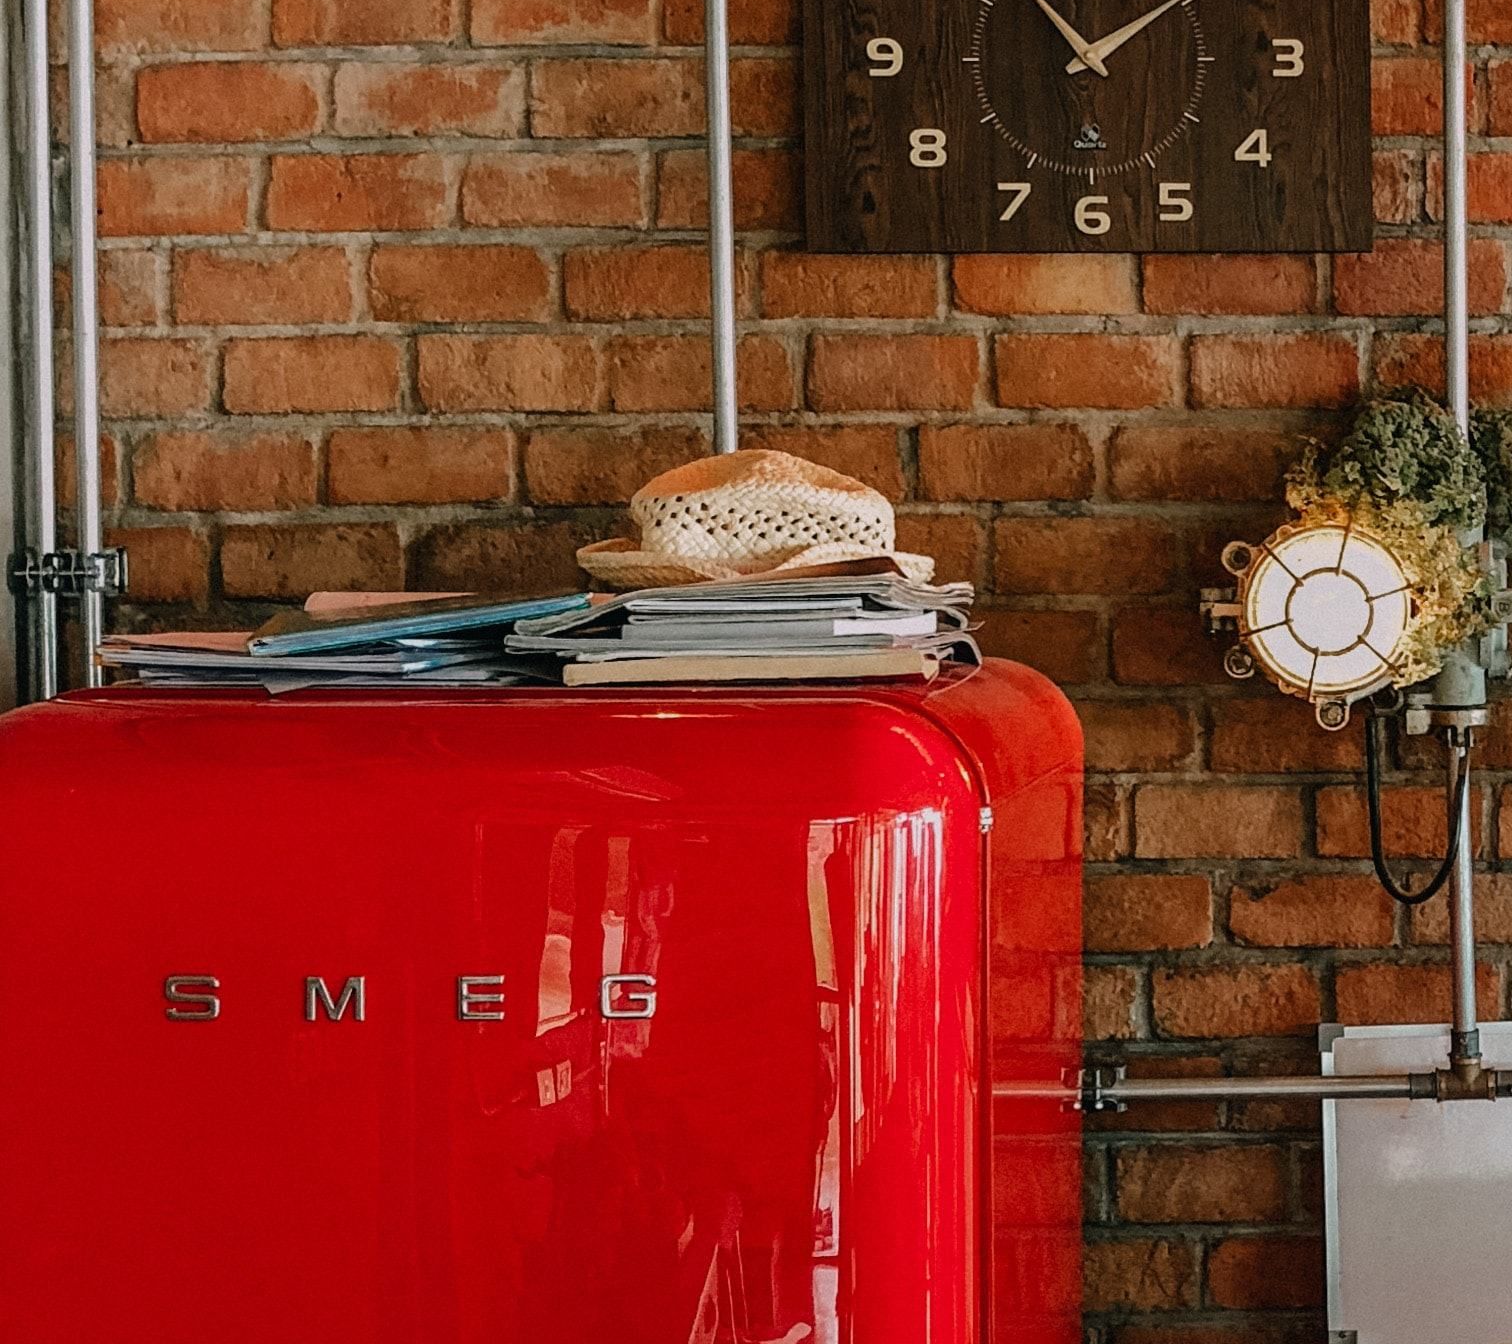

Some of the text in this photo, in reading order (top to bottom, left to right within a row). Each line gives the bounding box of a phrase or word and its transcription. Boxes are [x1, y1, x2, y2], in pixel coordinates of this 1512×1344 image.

[866, 37, 904, 77] 9
[1272, 38, 1305, 77] 3
[909, 128, 948, 168] 8
[1234, 128, 1272, 168] 4
[997, 182, 1032, 222] 7
[1074, 195, 1112, 235] 6
[1158, 182, 1193, 222] 5
[165, 974, 657, 1022] SMEG
